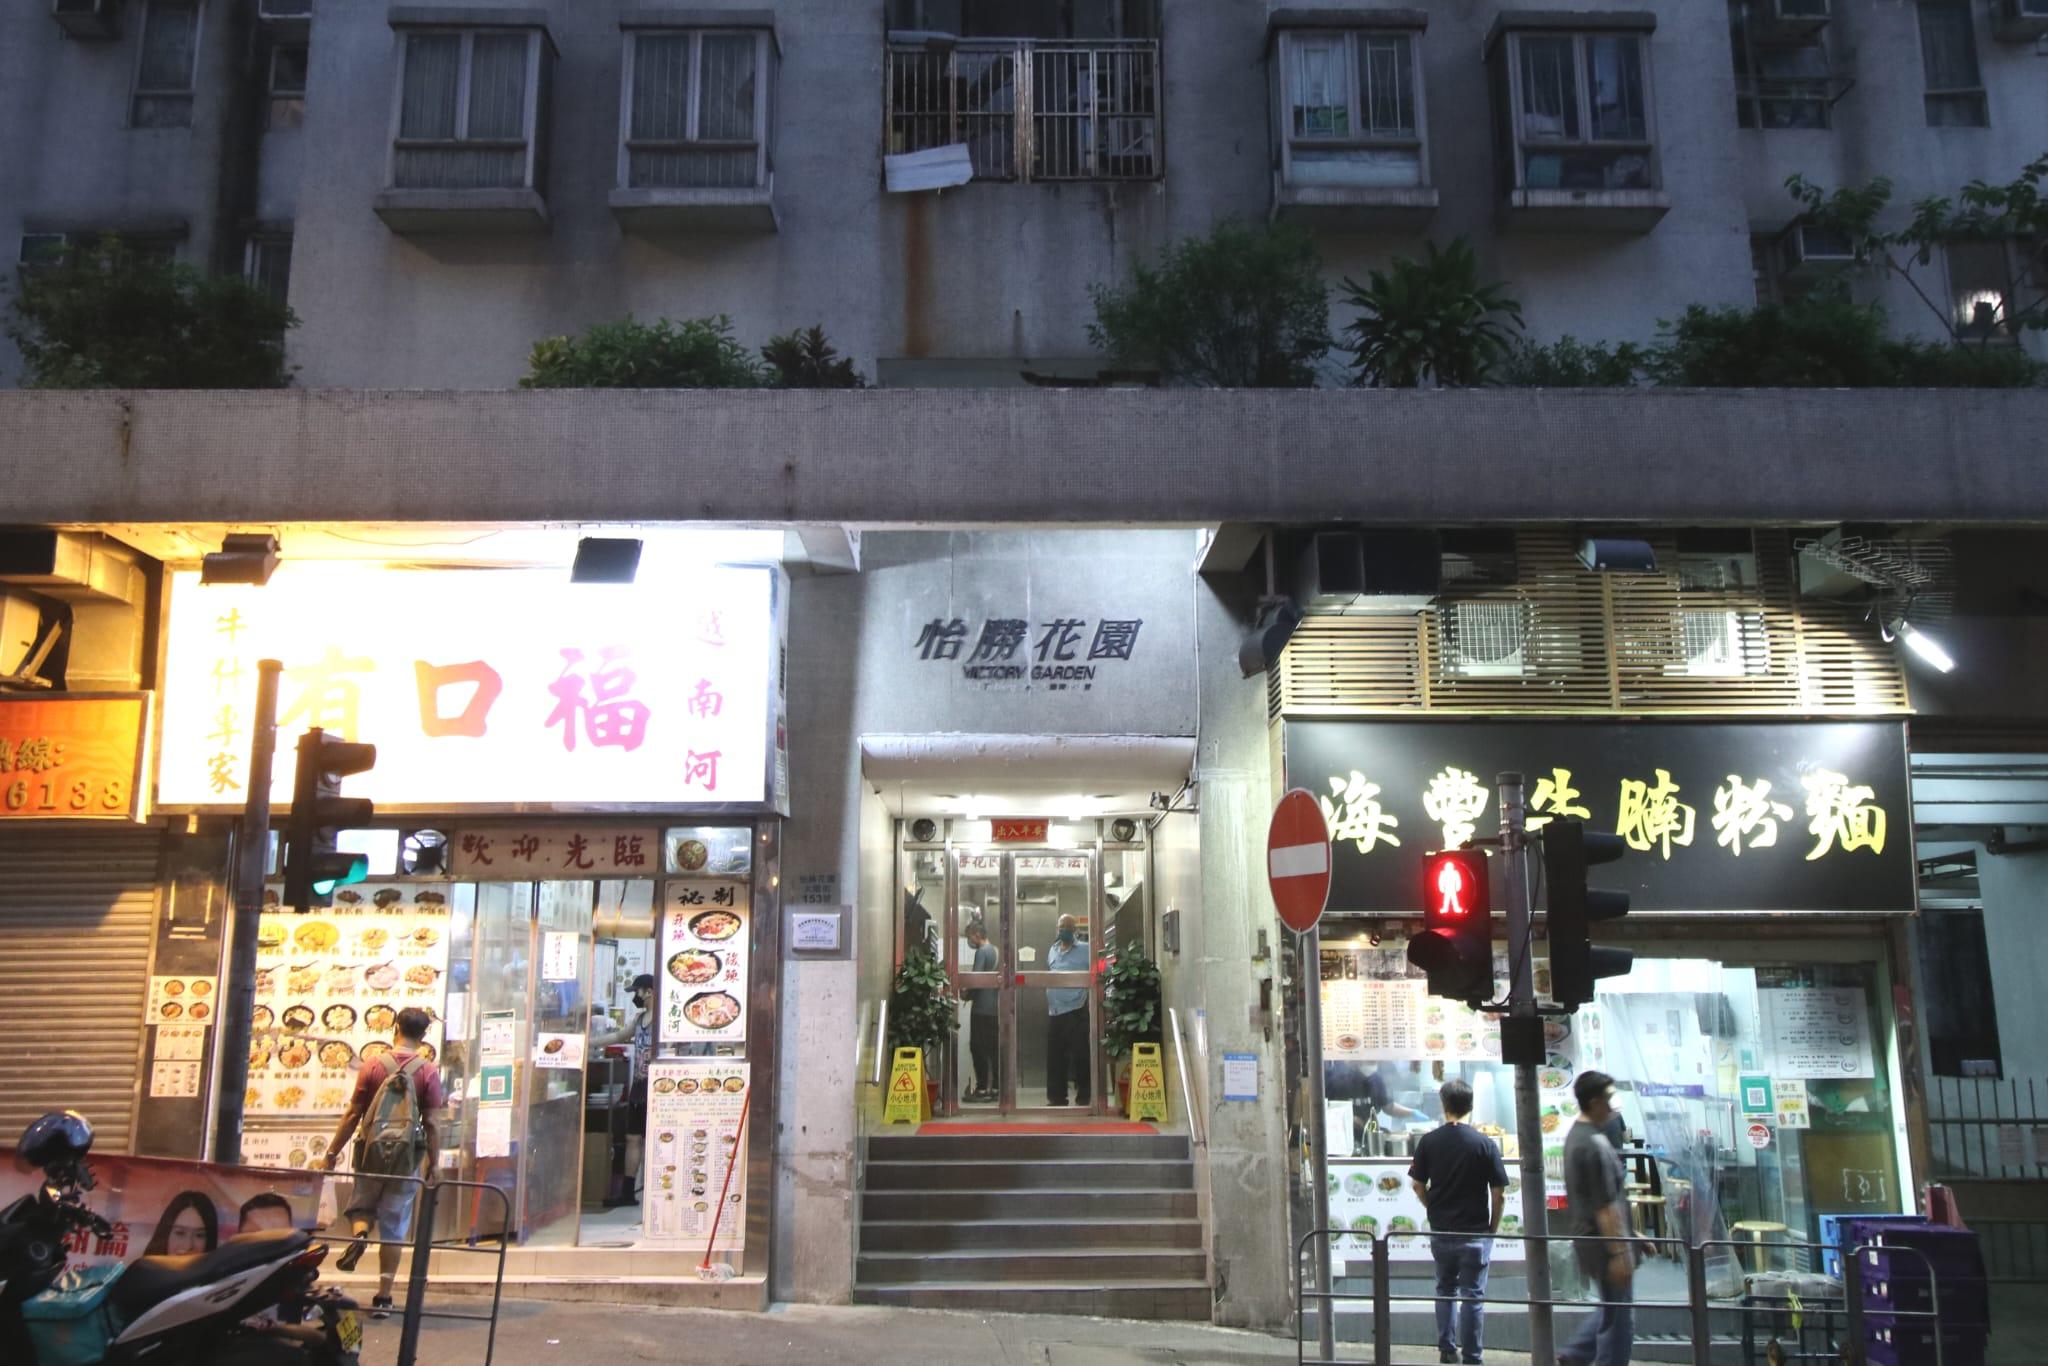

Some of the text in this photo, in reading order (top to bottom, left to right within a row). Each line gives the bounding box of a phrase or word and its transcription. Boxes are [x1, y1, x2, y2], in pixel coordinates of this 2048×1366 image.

[914, 617, 1143, 662] 怡勝花園
[1031, 665, 1097, 680] GARDEN
[277, 645, 651, 752] 有口福
[685, 610, 727, 791] 越南河
[996, 824, 1044, 837] 出入平安
[1322, 764, 1888, 861] 海豐牛腩粉麵
[462, 833, 645, 870] 歡迎光臨
